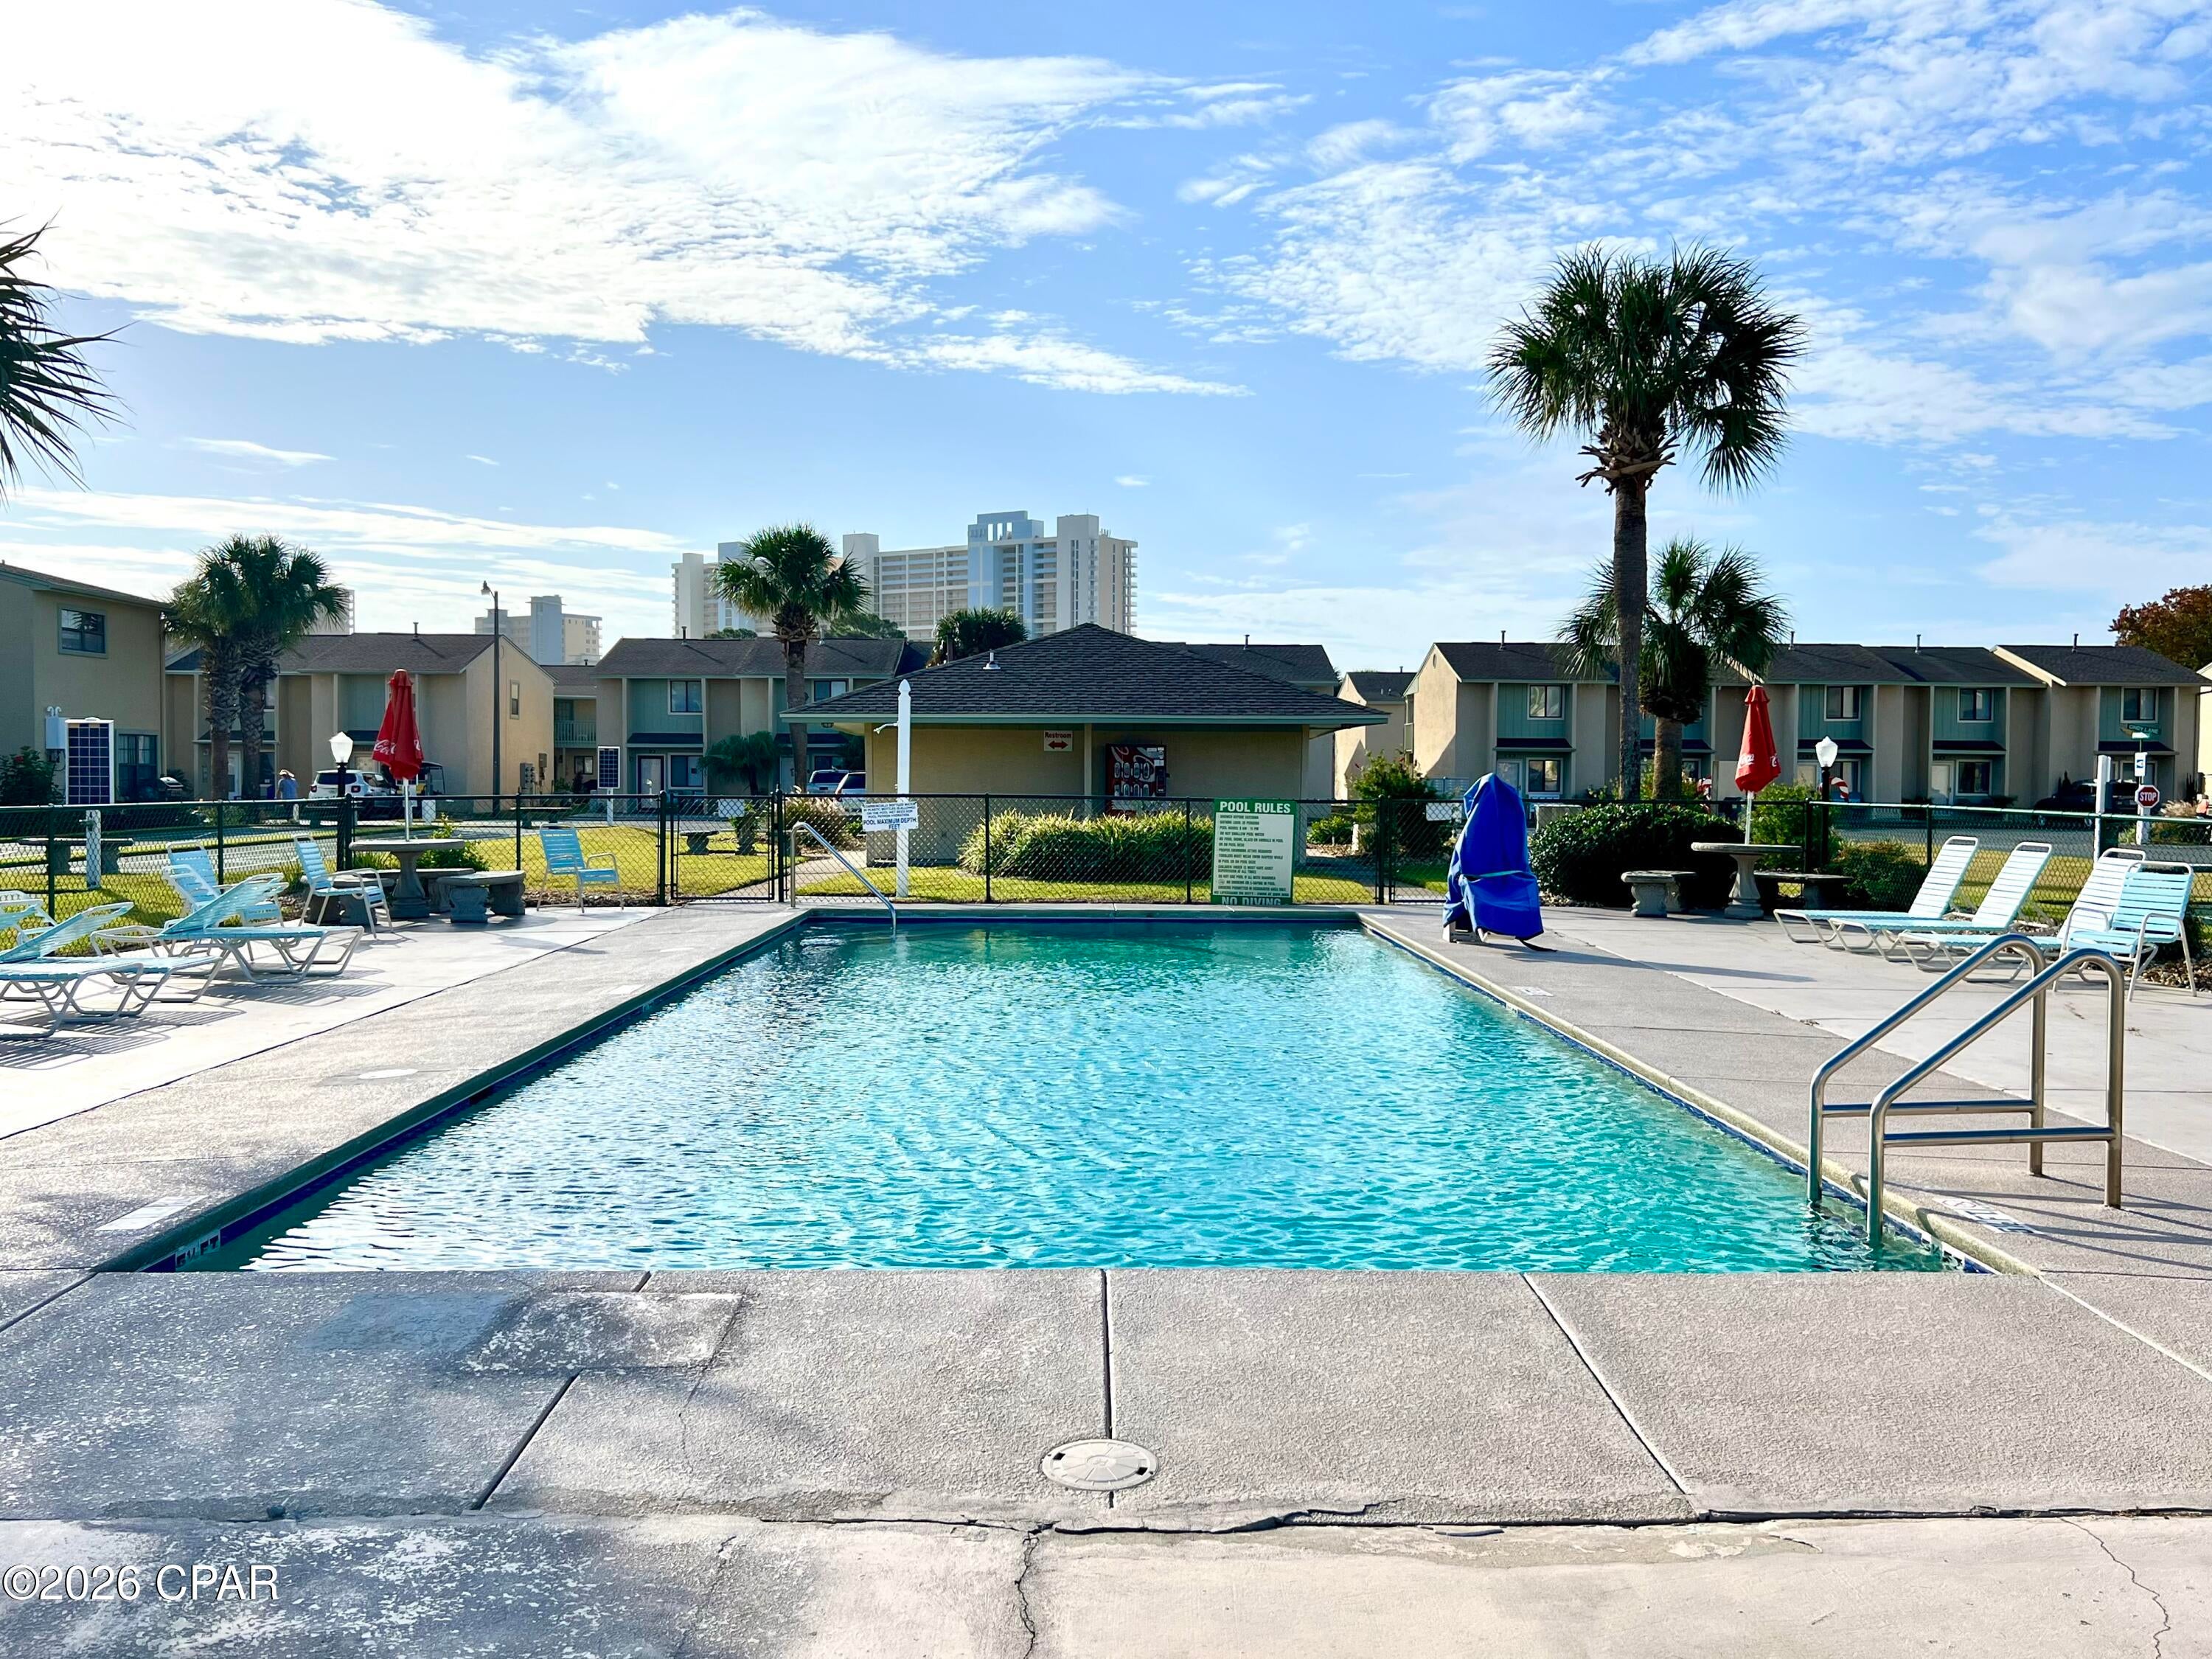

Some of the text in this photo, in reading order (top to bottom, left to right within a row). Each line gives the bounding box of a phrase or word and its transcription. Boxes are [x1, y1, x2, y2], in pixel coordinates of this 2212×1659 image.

[2139, 792, 2157, 801] STOP
[1220, 801, 1290, 813] POOL RULES
[1221, 896, 1281, 905] NO DIVING
[200, 1234, 219, 1256] FT
